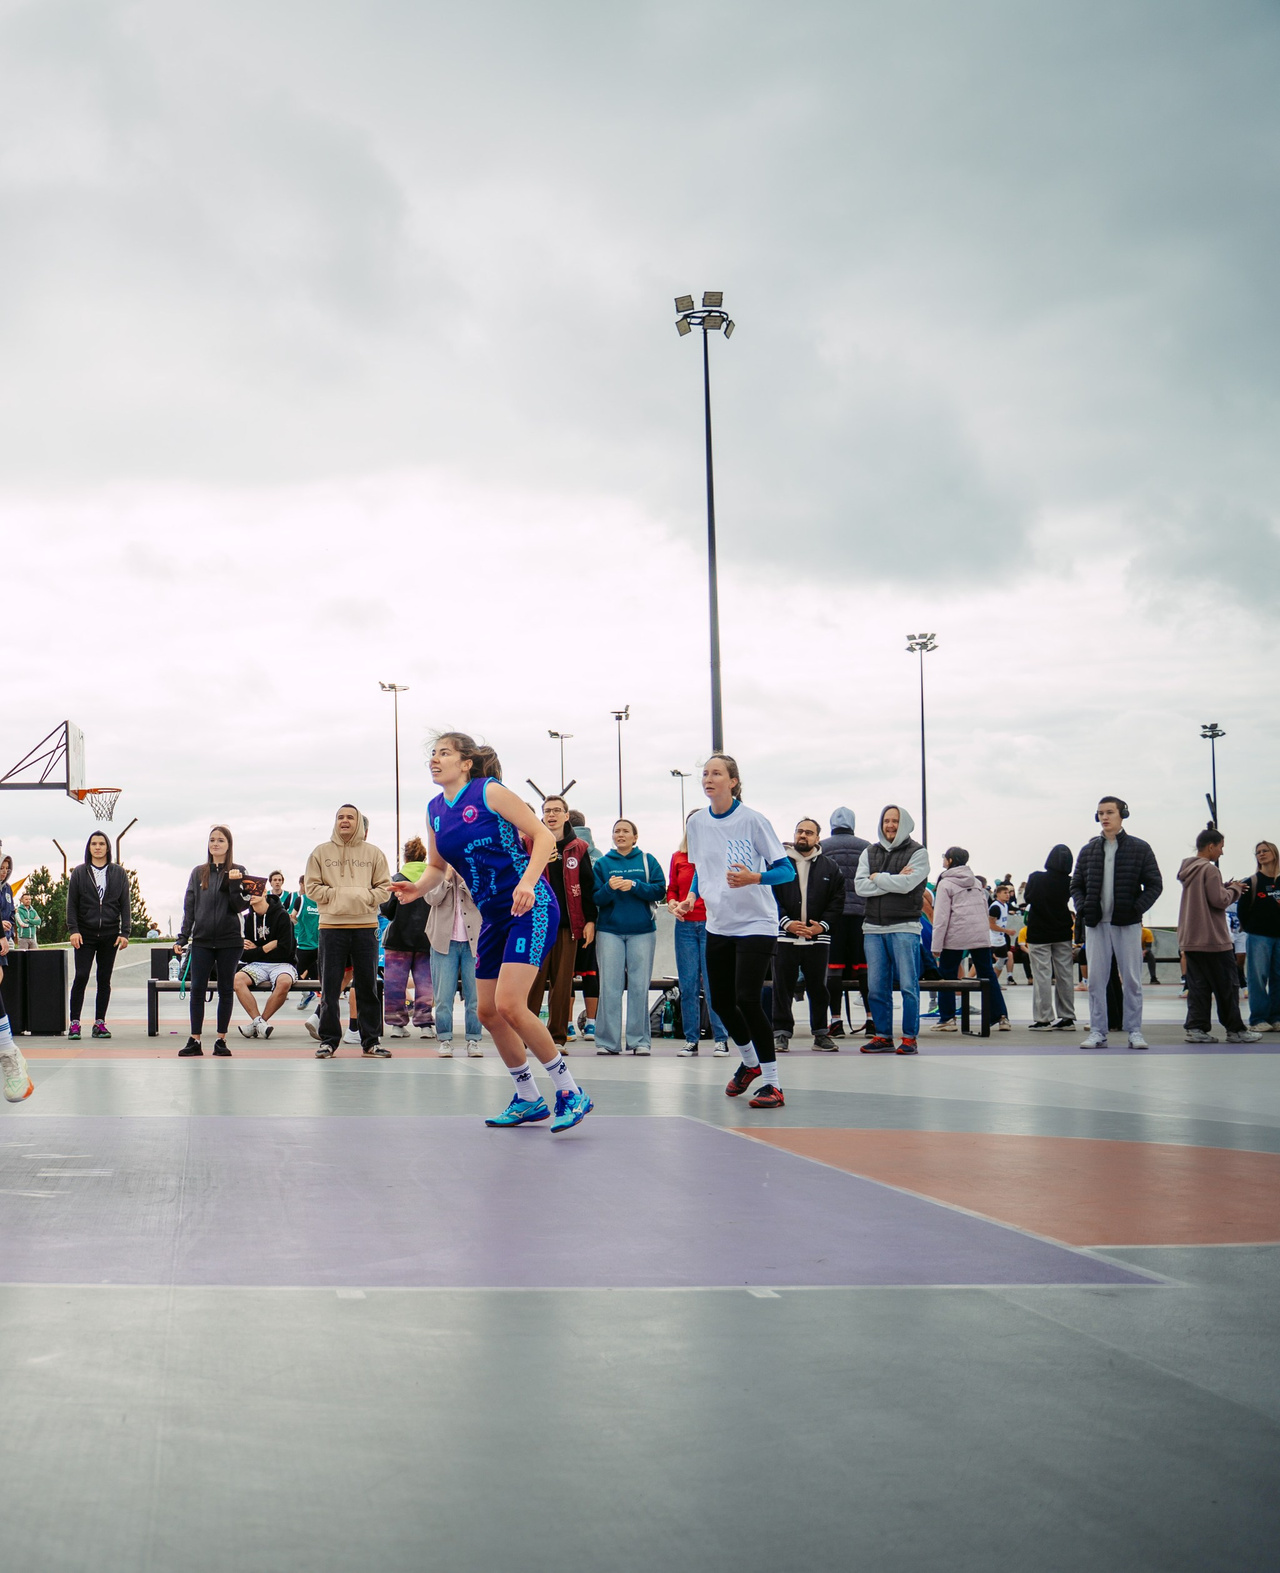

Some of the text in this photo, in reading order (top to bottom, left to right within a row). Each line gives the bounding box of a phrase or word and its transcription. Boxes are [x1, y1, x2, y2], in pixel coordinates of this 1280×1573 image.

[433, 816, 440, 832] 8
[464, 836, 493, 854] team
[324, 858, 350, 868] Calvn
[515, 937, 526, 954] 8
